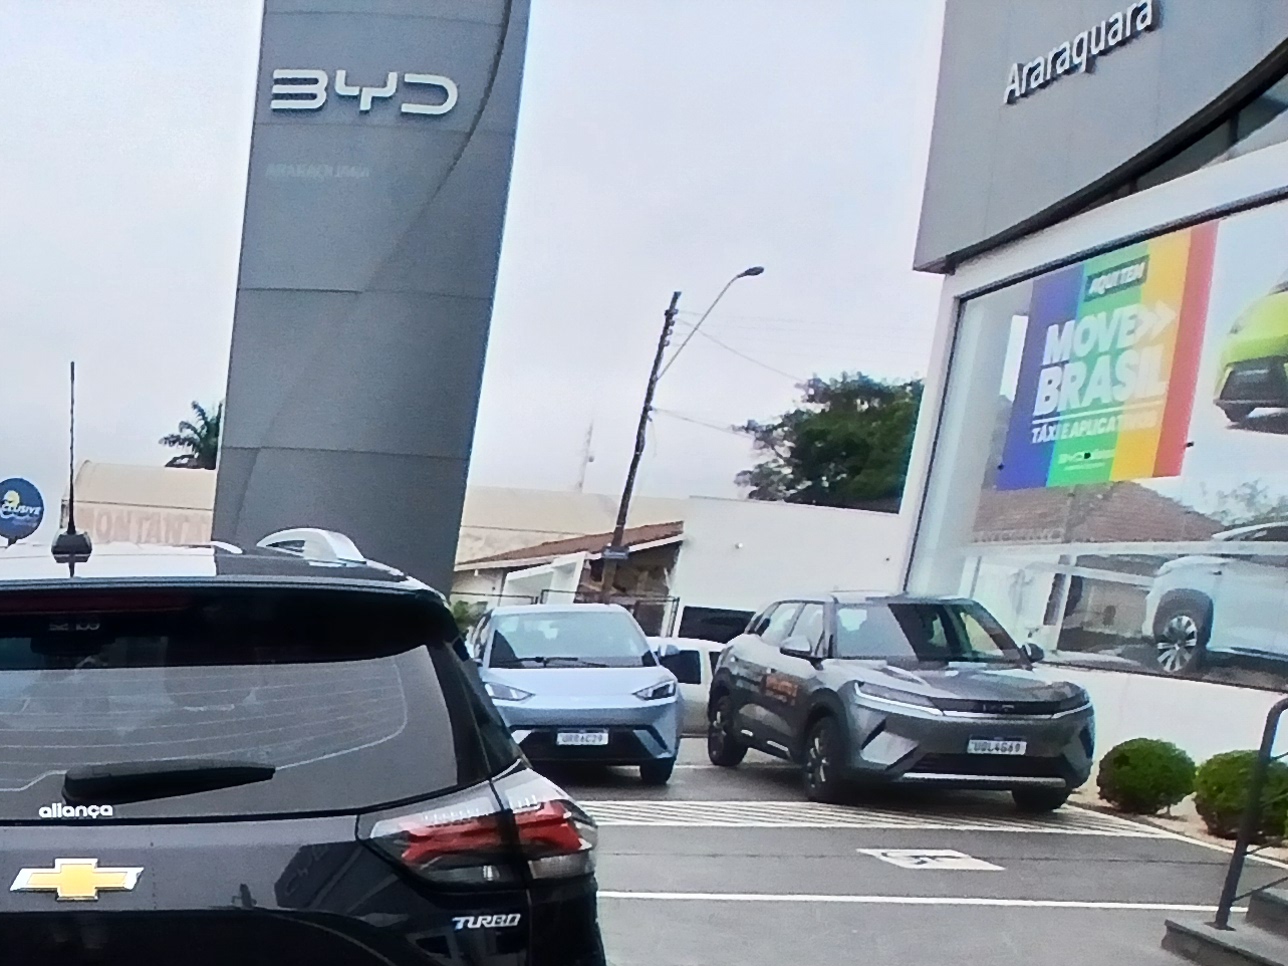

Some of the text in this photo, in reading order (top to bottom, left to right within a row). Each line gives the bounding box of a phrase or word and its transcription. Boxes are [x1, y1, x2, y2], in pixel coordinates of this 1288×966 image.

[1003, 0, 1152, 104] Araraquara
[270, 69, 459, 116] BYD
[1042, 303, 1140, 366] MOVE
[1032, 344, 1169, 417] BRASIL
[38, 802, 114, 819] aliança
[452, 913, 521, 930] TURBO
